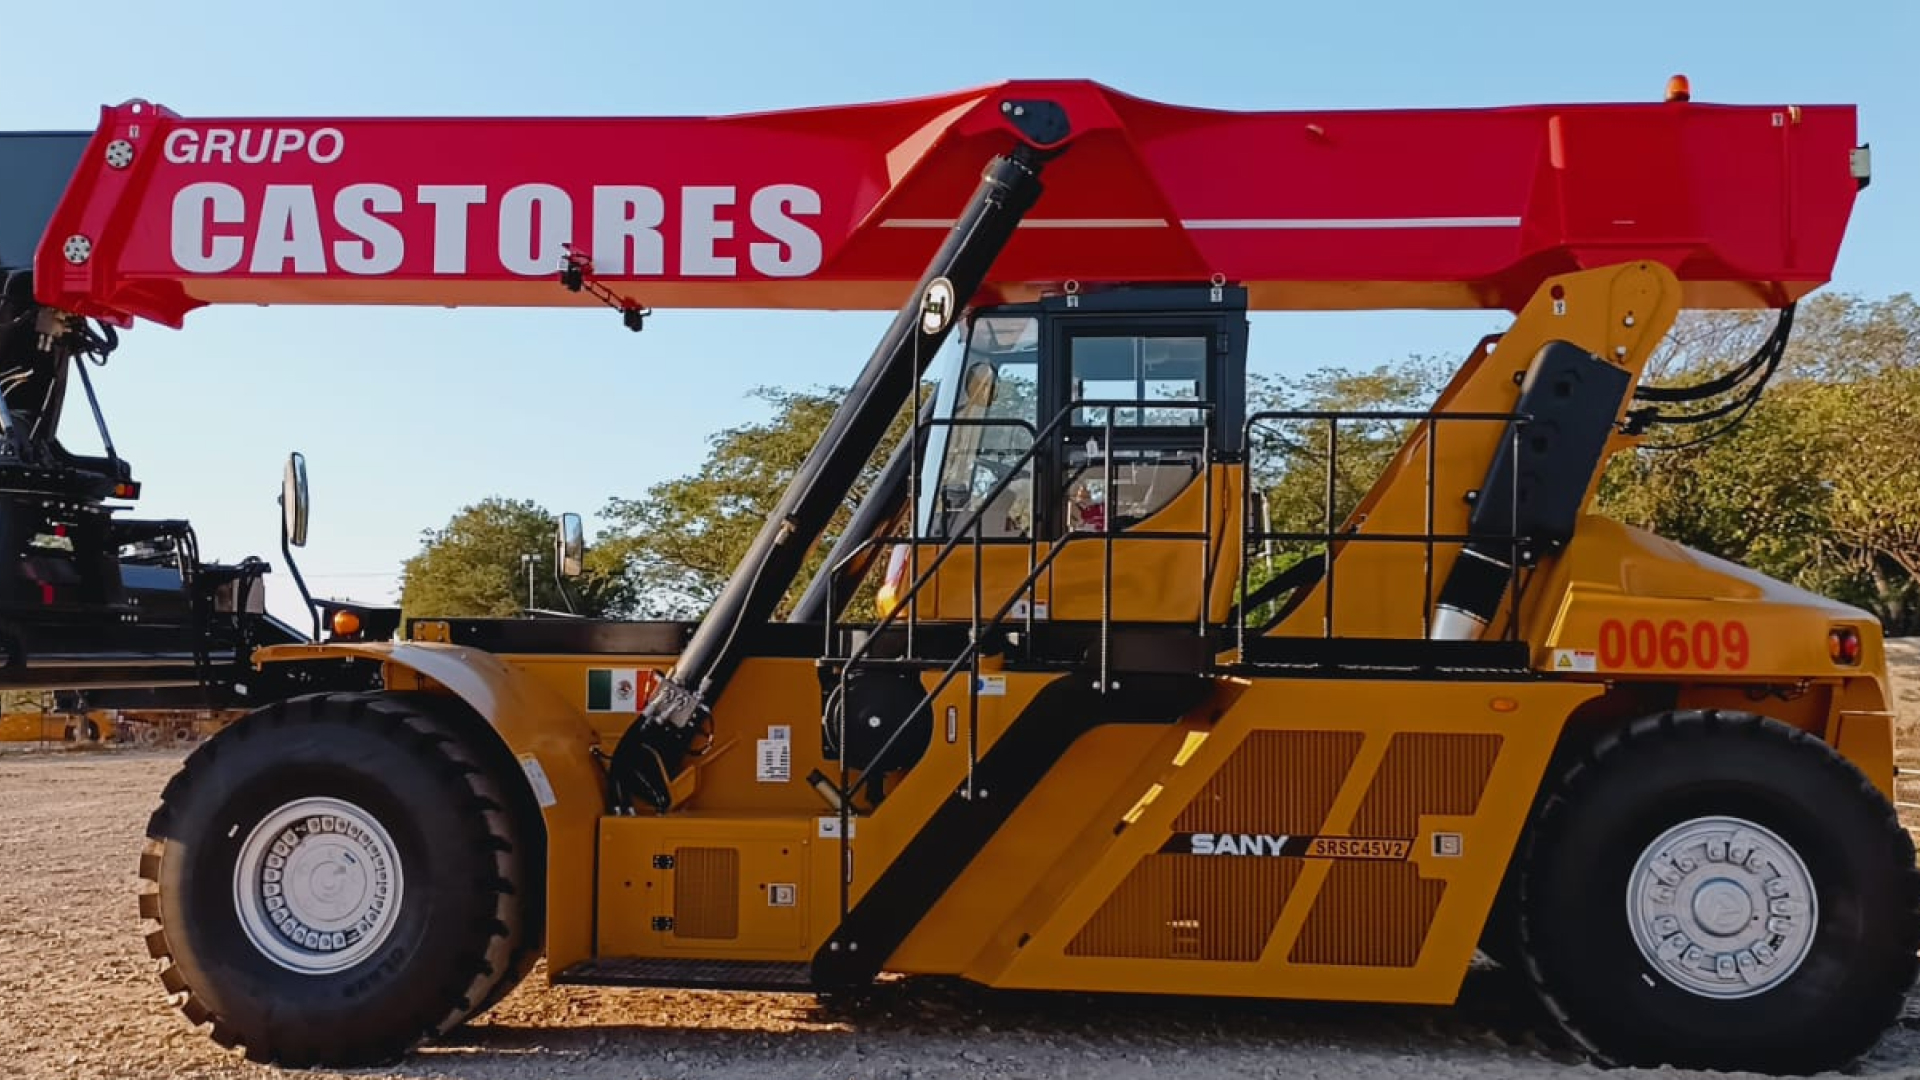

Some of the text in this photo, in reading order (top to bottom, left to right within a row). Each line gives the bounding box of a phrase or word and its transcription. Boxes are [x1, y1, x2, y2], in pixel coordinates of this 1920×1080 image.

[164, 128, 344, 164] GRUPO
[171, 182, 823, 277] CASTORES
[1600, 619, 1749, 669] 00609
[1191, 833, 1403, 857] SANY SRSC45V2
